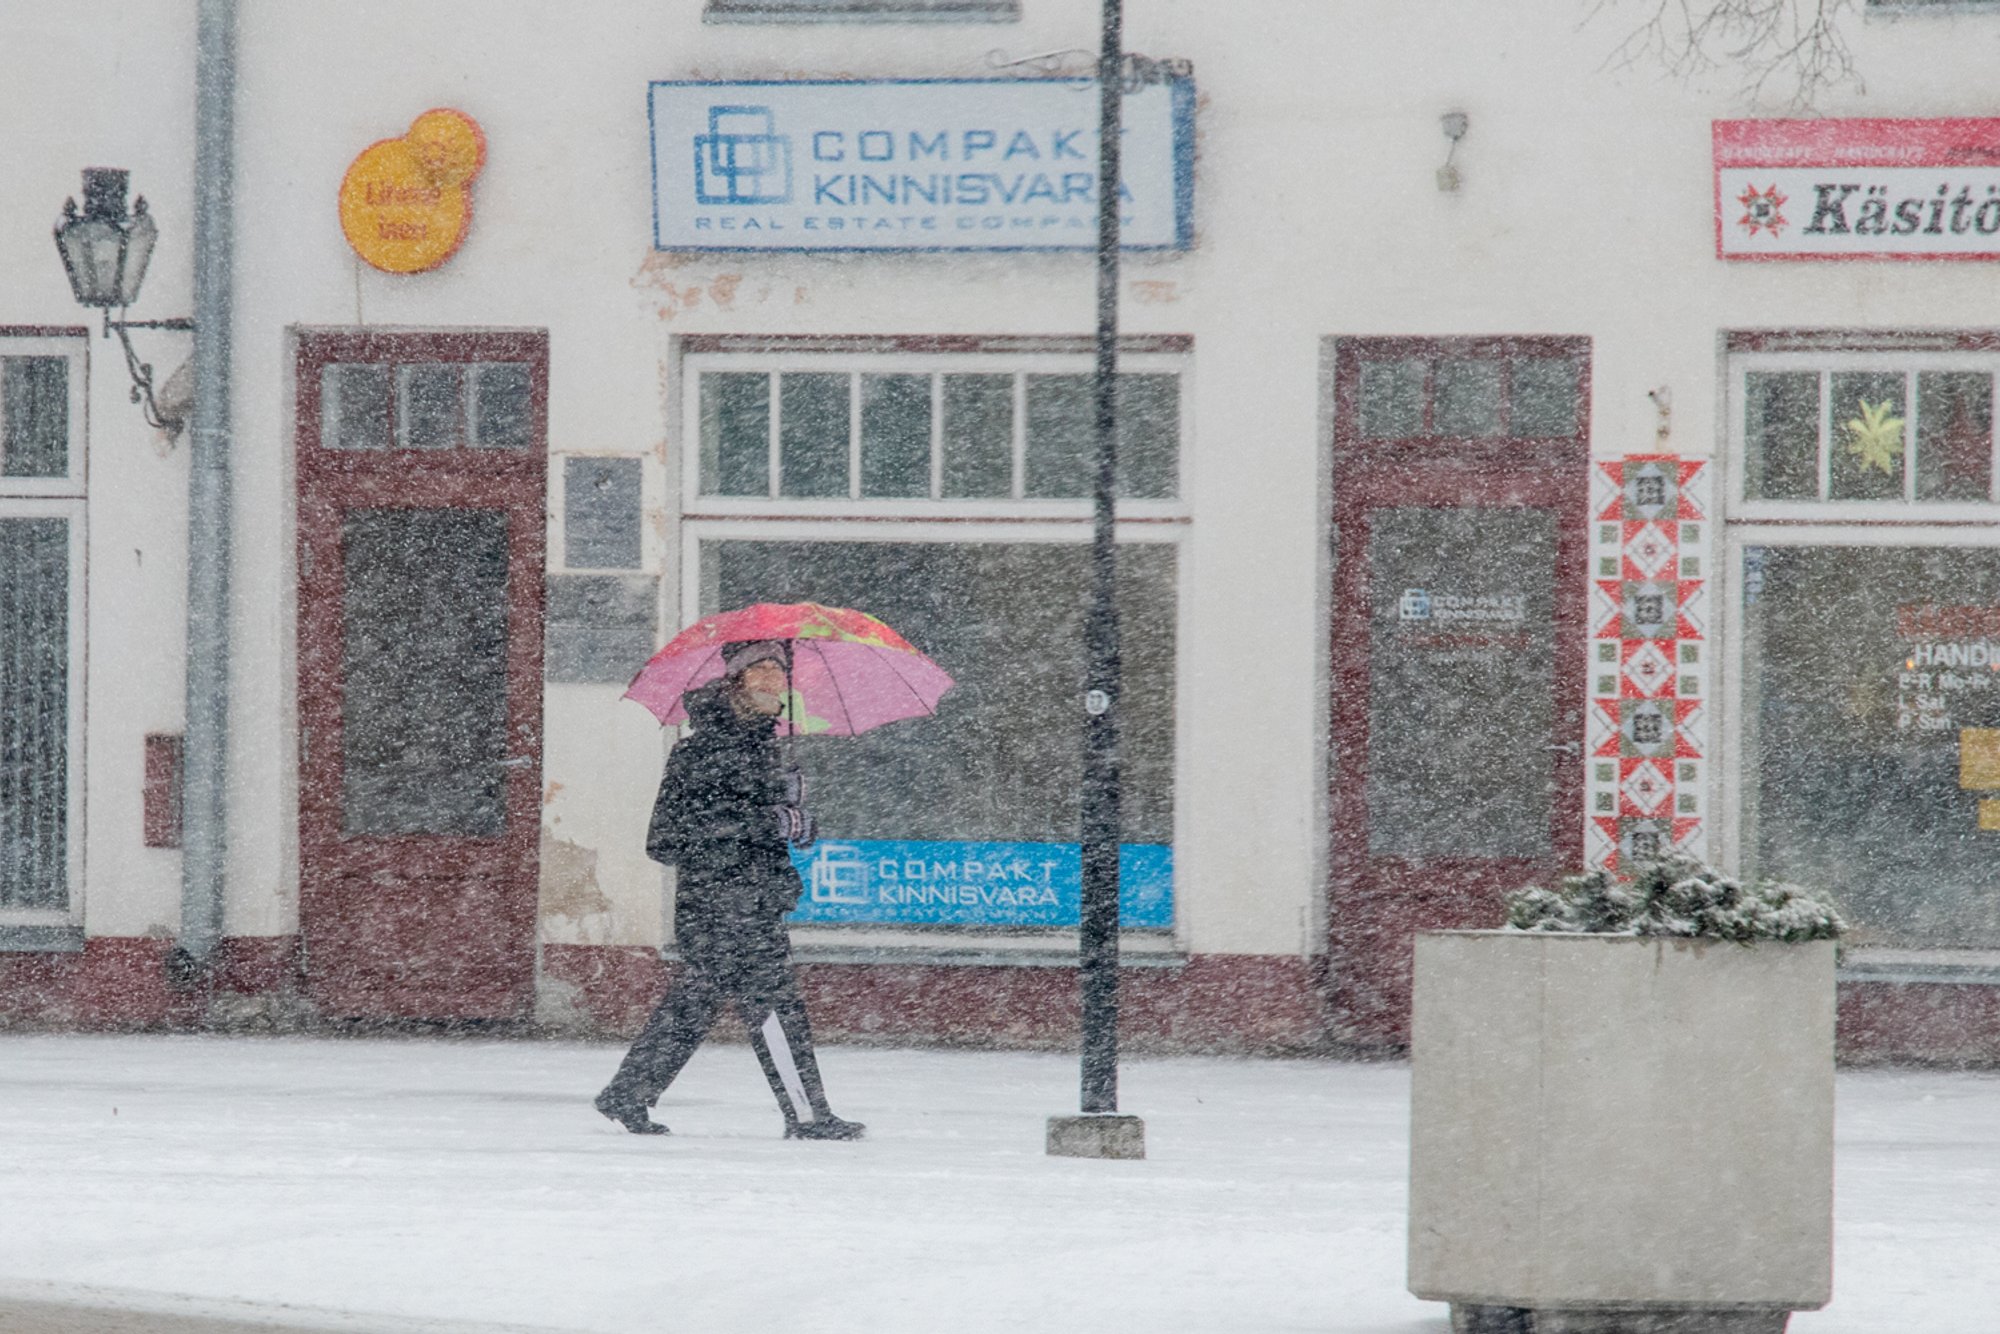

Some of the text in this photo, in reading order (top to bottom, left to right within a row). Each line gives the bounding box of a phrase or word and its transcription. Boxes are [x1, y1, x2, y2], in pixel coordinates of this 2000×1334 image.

[695, 216, 784, 230] REAL
[804, 216, 938, 230] ESTATE
[878, 858, 1058, 882] COMPAKT
[878, 885, 1060, 907] KINNISVARA
